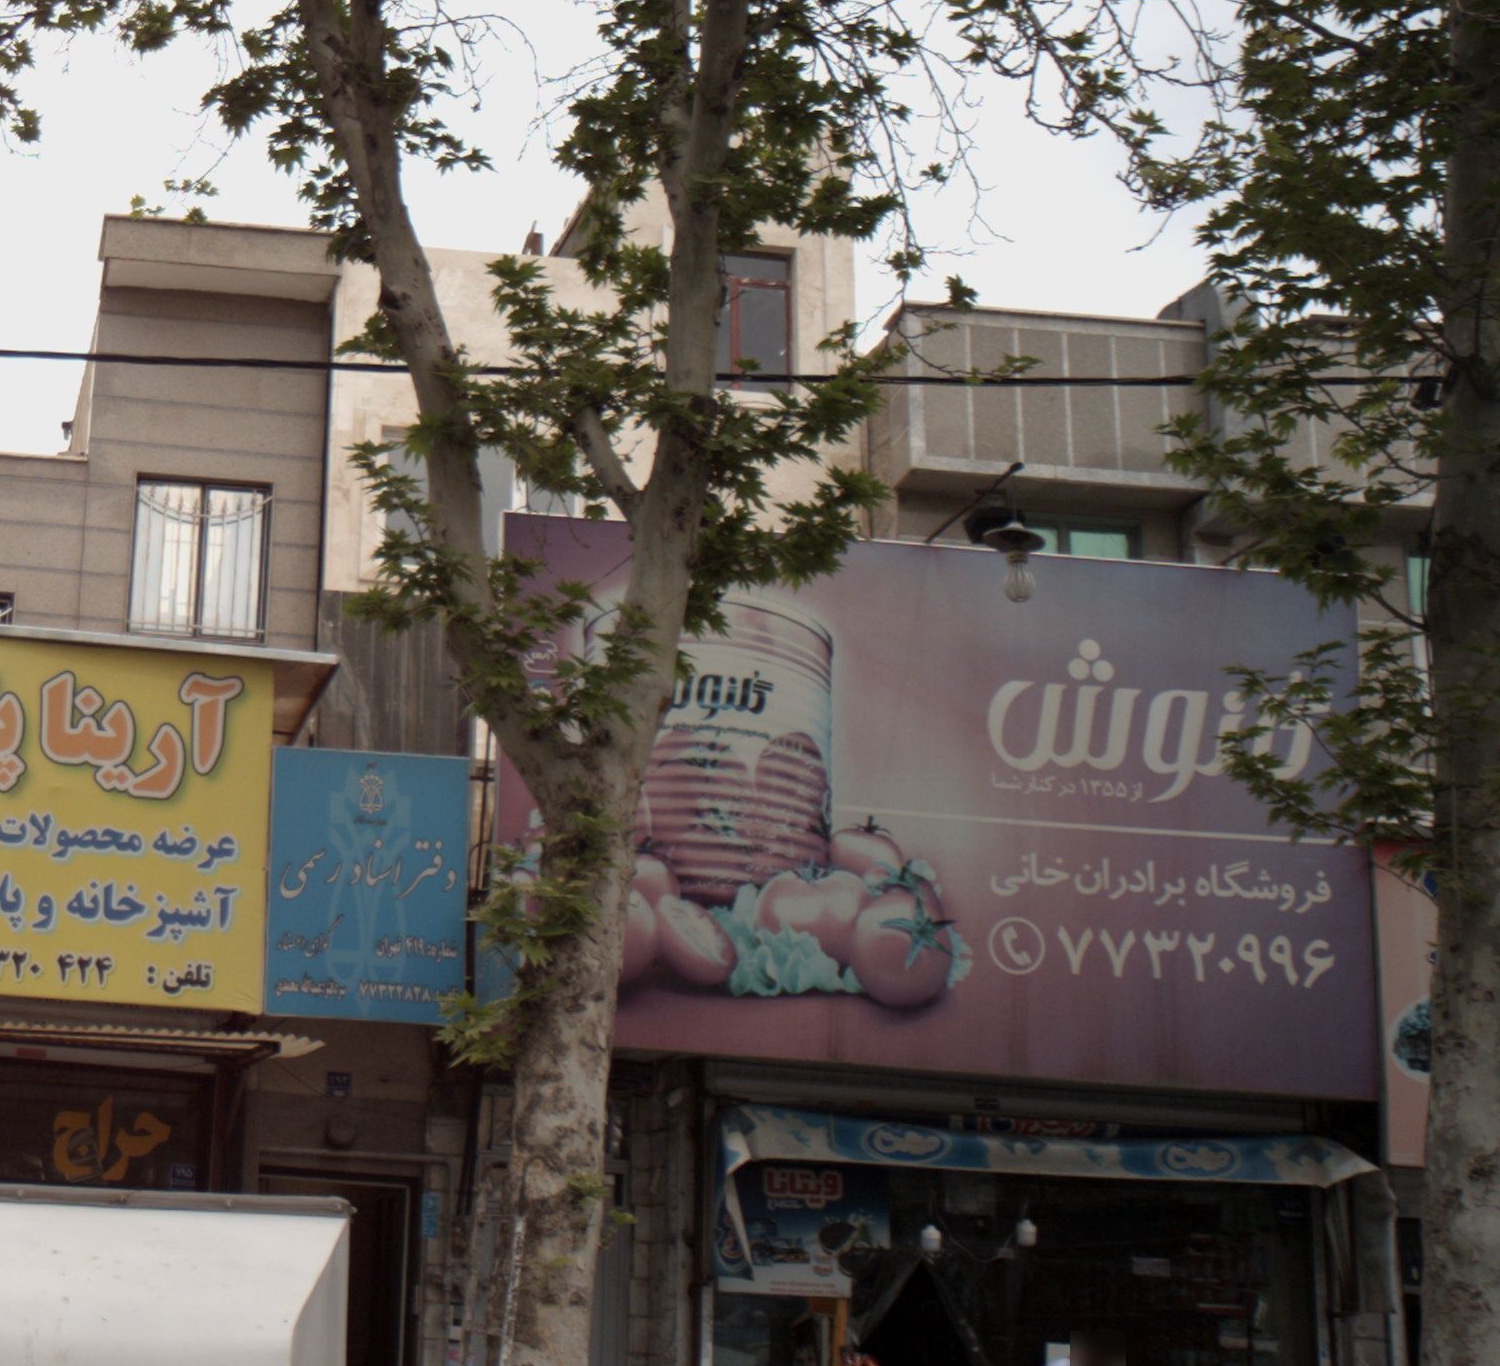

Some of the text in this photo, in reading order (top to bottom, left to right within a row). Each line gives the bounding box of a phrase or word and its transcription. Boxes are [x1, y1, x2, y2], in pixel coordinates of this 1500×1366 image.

[40, 670, 245, 799] آرینا
[991, 771, 1023, 790] شما
[1023, 775, 1057, 794] کنار
[1057, 781, 1077, 798] در
[1129, 780, 1144, 803] از
[152, 825, 237, 870] عرضه
[279, 837, 457, 900] دفتر اسناد رسمی
[990, 852, 1332, 914] فروشگاه برادران خانی
[31, 892, 55, 929] و
[66, 882, 239, 942] آشپزخانه
[1057, 924, 1336, 989] ۷۷۳۲۰۹۹۶
[52, 1095, 172, 1182] حراج
